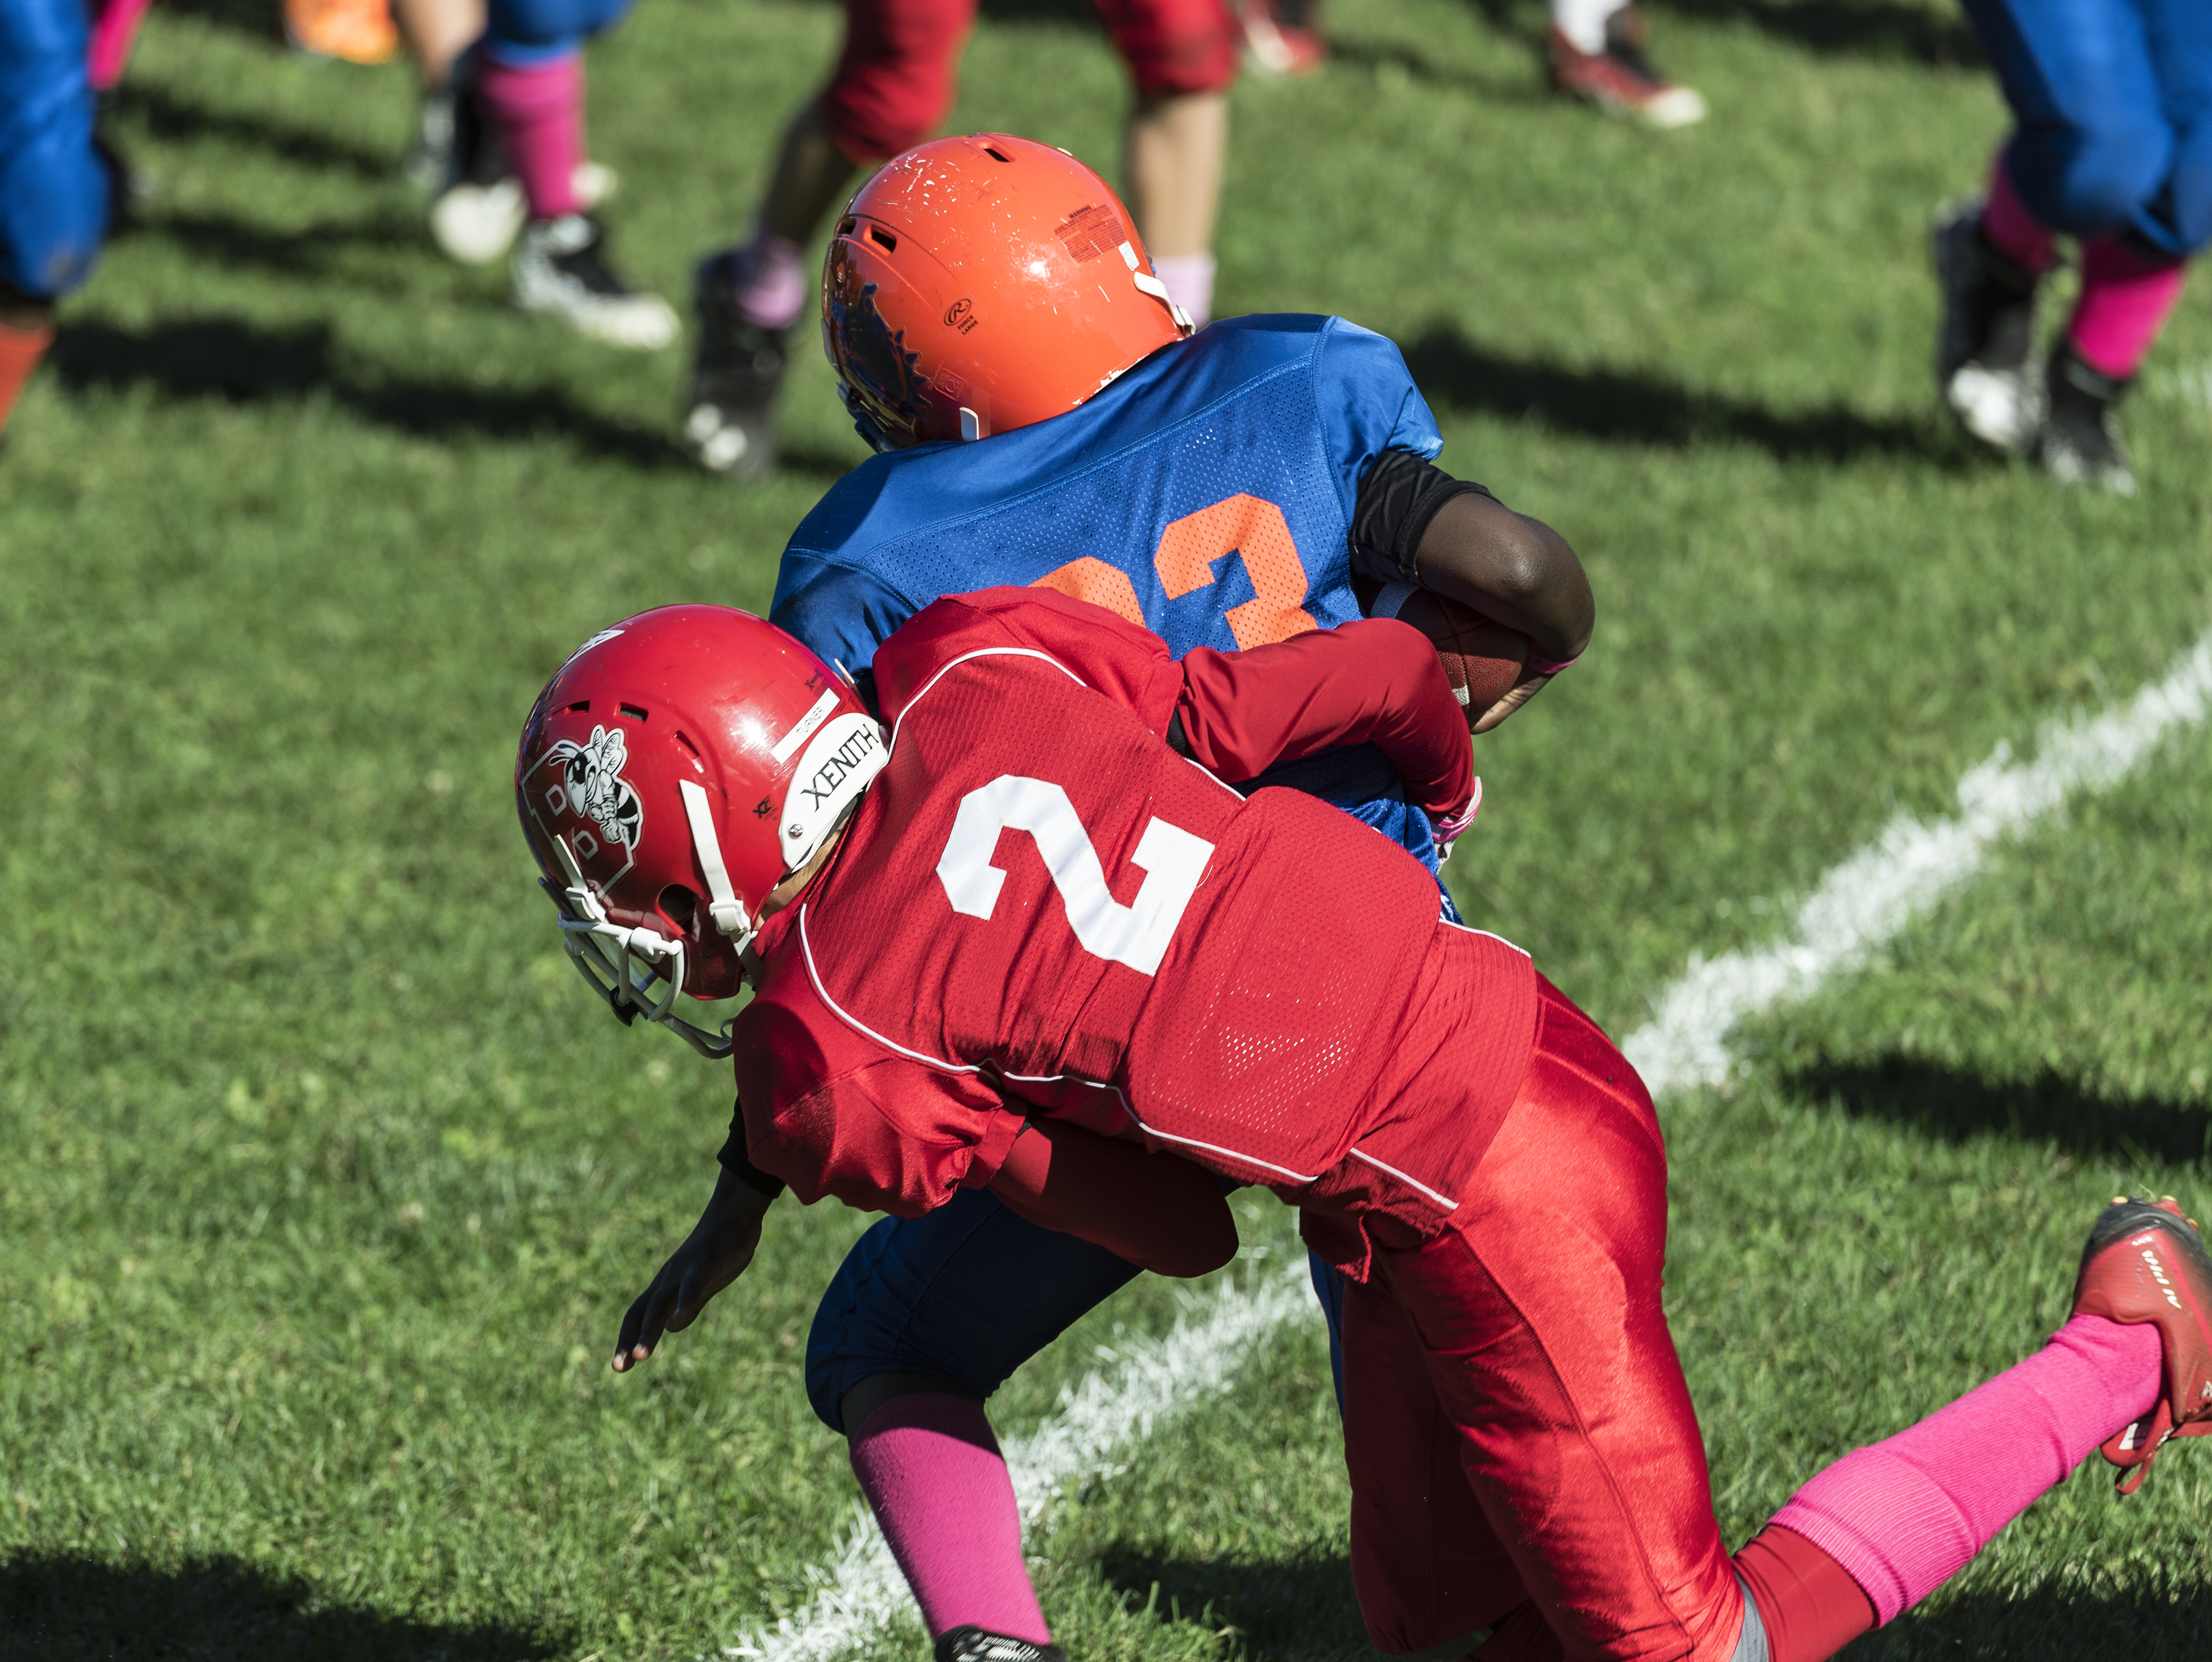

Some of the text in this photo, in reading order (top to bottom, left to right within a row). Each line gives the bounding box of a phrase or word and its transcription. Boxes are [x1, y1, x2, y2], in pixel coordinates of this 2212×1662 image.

[1068, 205, 1092, 219] WARNING
[958, 315, 974, 330] FORCE
[962, 320, 979, 335] LARGE
[1028, 493, 1318, 651] 3
[799, 723, 879, 813] XENITH
[936, 774, 1216, 977] 2
